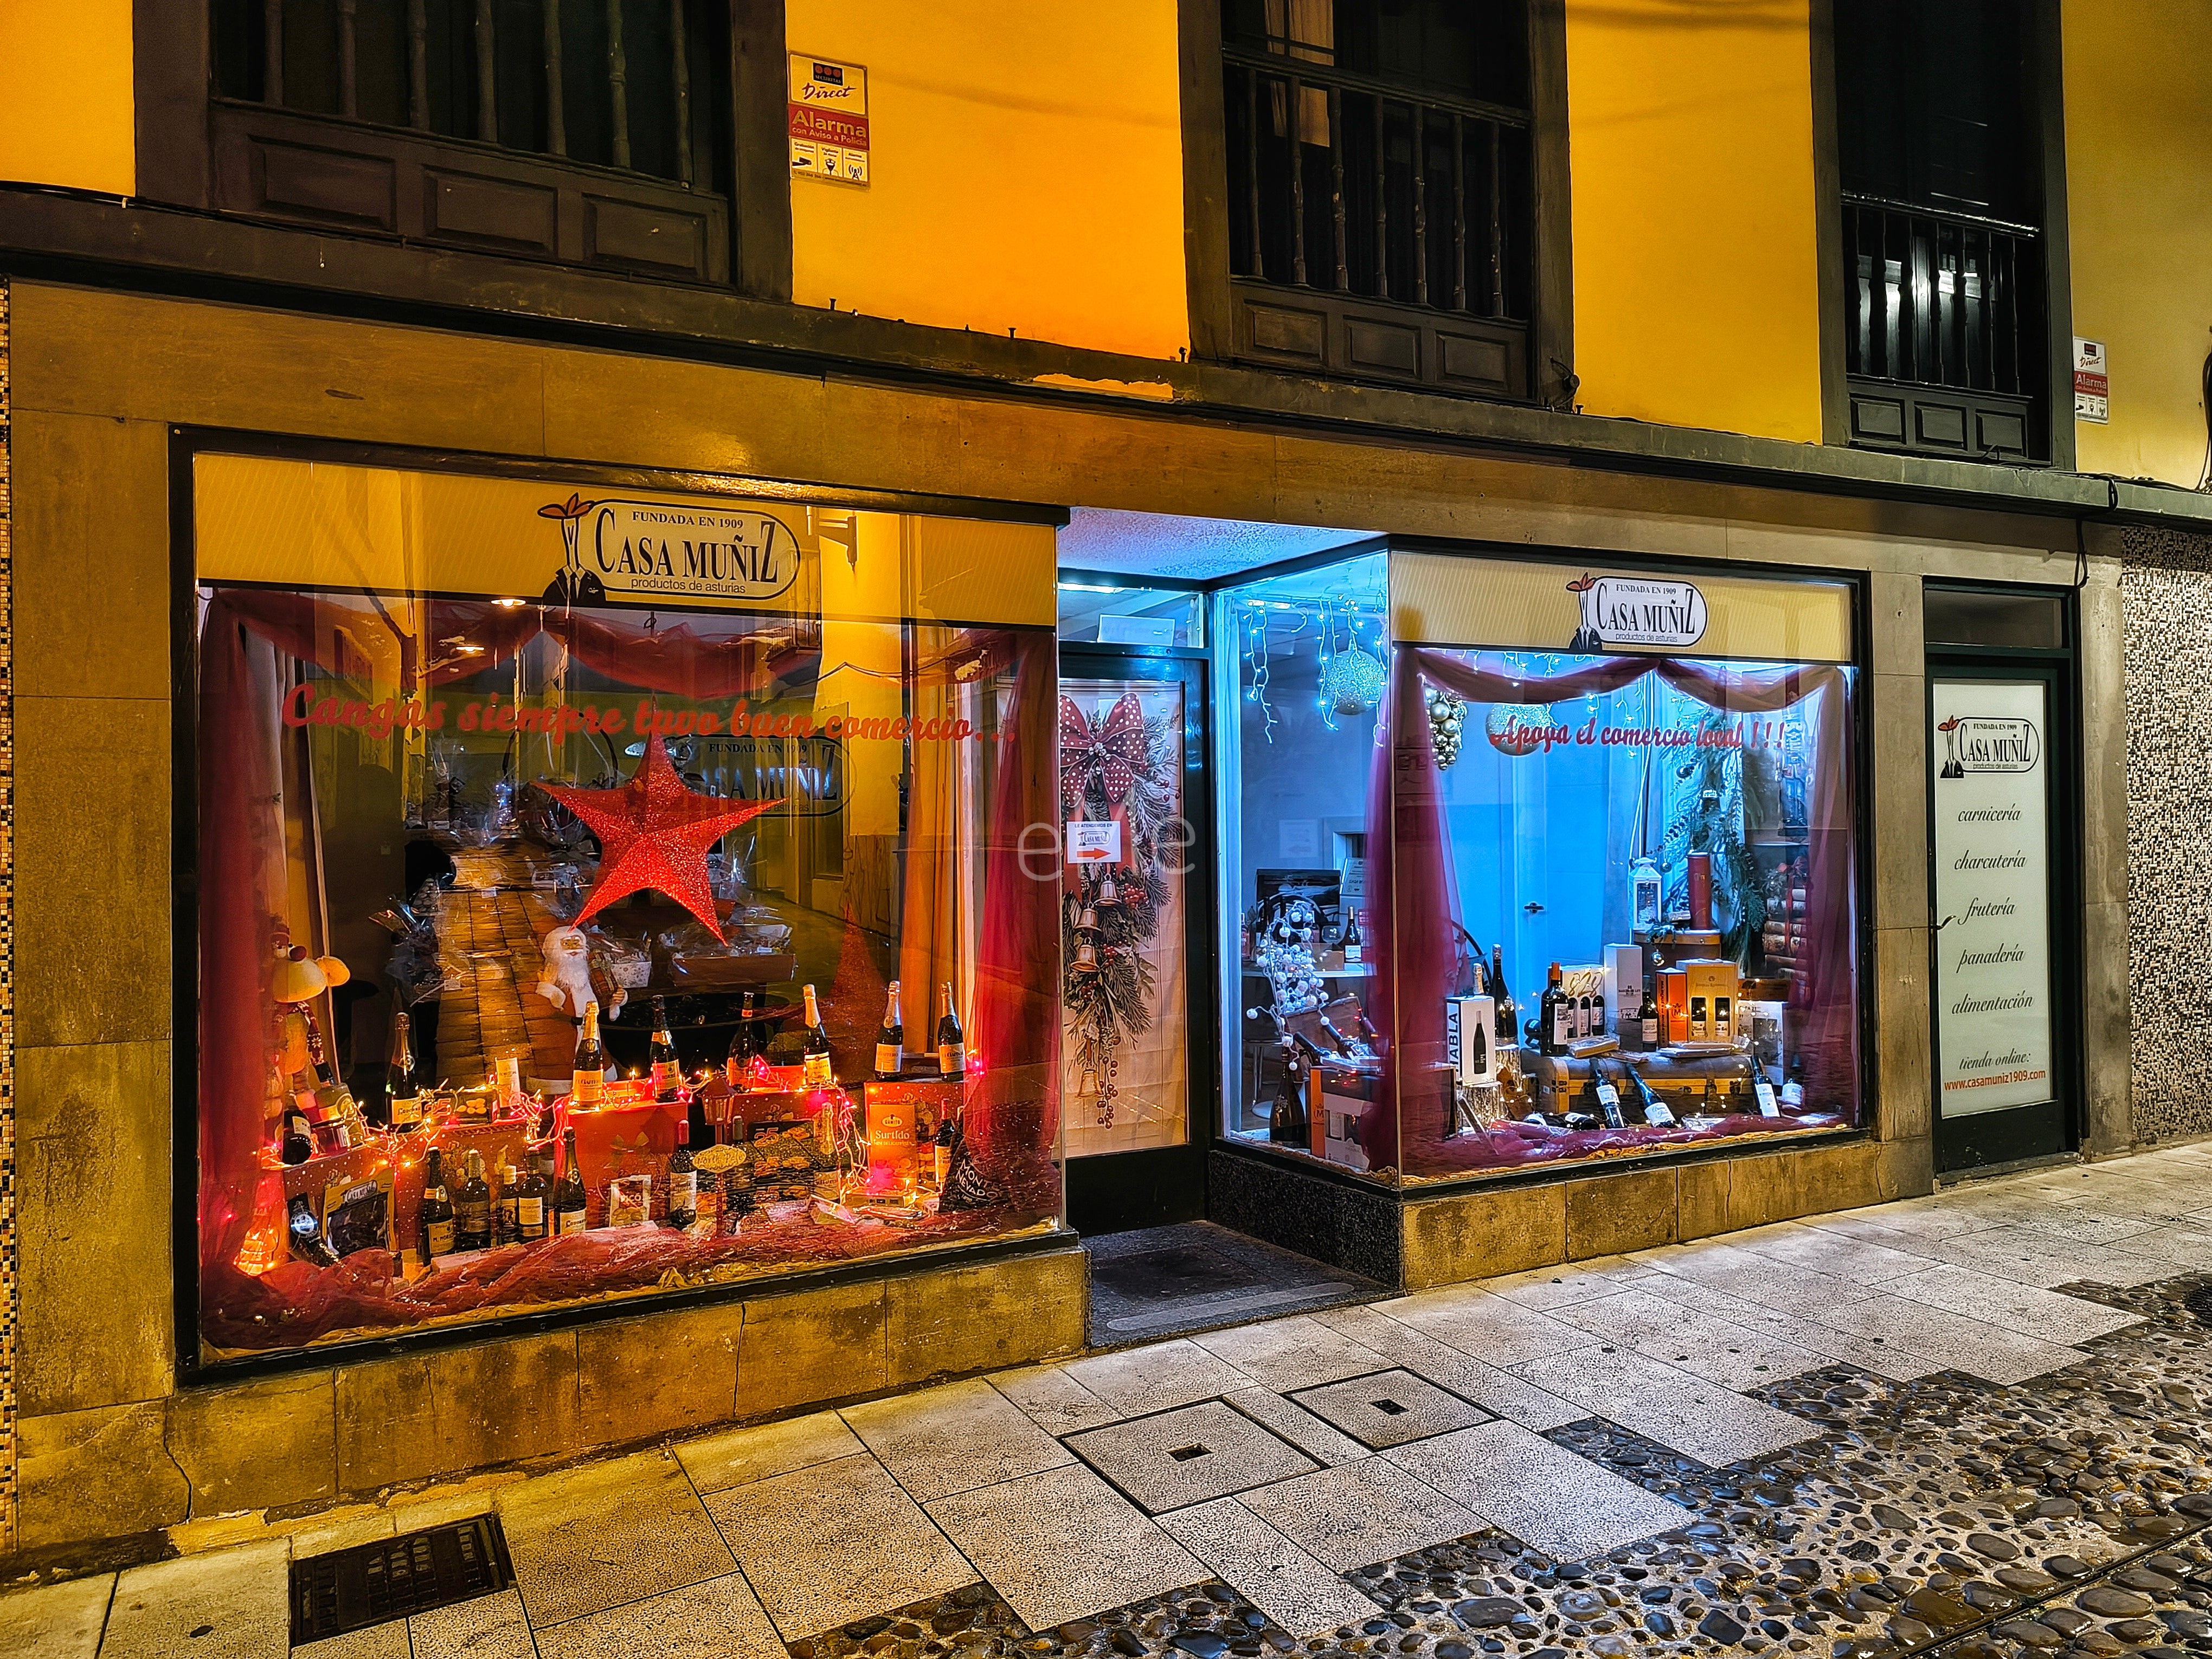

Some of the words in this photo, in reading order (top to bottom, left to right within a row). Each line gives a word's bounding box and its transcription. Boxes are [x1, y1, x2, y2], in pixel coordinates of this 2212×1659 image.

[802, 82, 857, 100] Direct
[792, 110, 867, 138] Alarma
[792, 127, 807, 135] con
[808, 128, 832, 139] Aviso
[2079, 356, 2102, 368] Direct
[2076, 374, 2107, 389] Alarma
[632, 511, 695, 526] FUNDADA
[698, 516, 715, 527] EN
[718, 518, 744, 529] 1909
[595, 507, 675, 577] CASA
[681, 520, 779, 584] MUÑIZ
[631, 578, 686, 590] productos
[689, 580, 703, 591] de
[705, 582, 746, 594] asturias
[1616, 584, 1650, 594] FUNDADA
[1663, 587, 1676, 595] 1909
[1596, 582, 1638, 632] CASA
[1643, 588, 1695, 634] MUÑIZ
[1616, 632, 1645, 642] productos
[1646, 633, 1654, 642] de
[1655, 634, 1678, 643] asturias
[282, 683, 445, 740] Cangas
[456, 691, 627, 745] siempre
[633, 702, 723, 736] tuvo
[730, 698, 820, 740] buen
[1489, 715, 1571, 753] Apoya
[1576, 717, 1598, 745] el
[1600, 722, 1692, 747] comercio
[1696, 719, 1744, 748] local
[1959, 722, 1990, 762] CASA
[1992, 723, 2031, 762] MUÑIZ
[709, 743, 764, 754] FUNDADA
[1958, 803, 2021, 822] carnicería
[1954, 849, 2026, 870] charcutería
[1957, 897, 2016, 925] frutería
[1956, 942, 2024, 974] panadería
[1951, 990, 2034, 1015] alimentación
[1959, 1050, 1992, 1070] tienda
[1995, 1047, 2031, 1066] online:
[1944, 1070, 2046, 1091] www.casamuniz1909.com
[875, 1130, 910, 1139] Surtido
